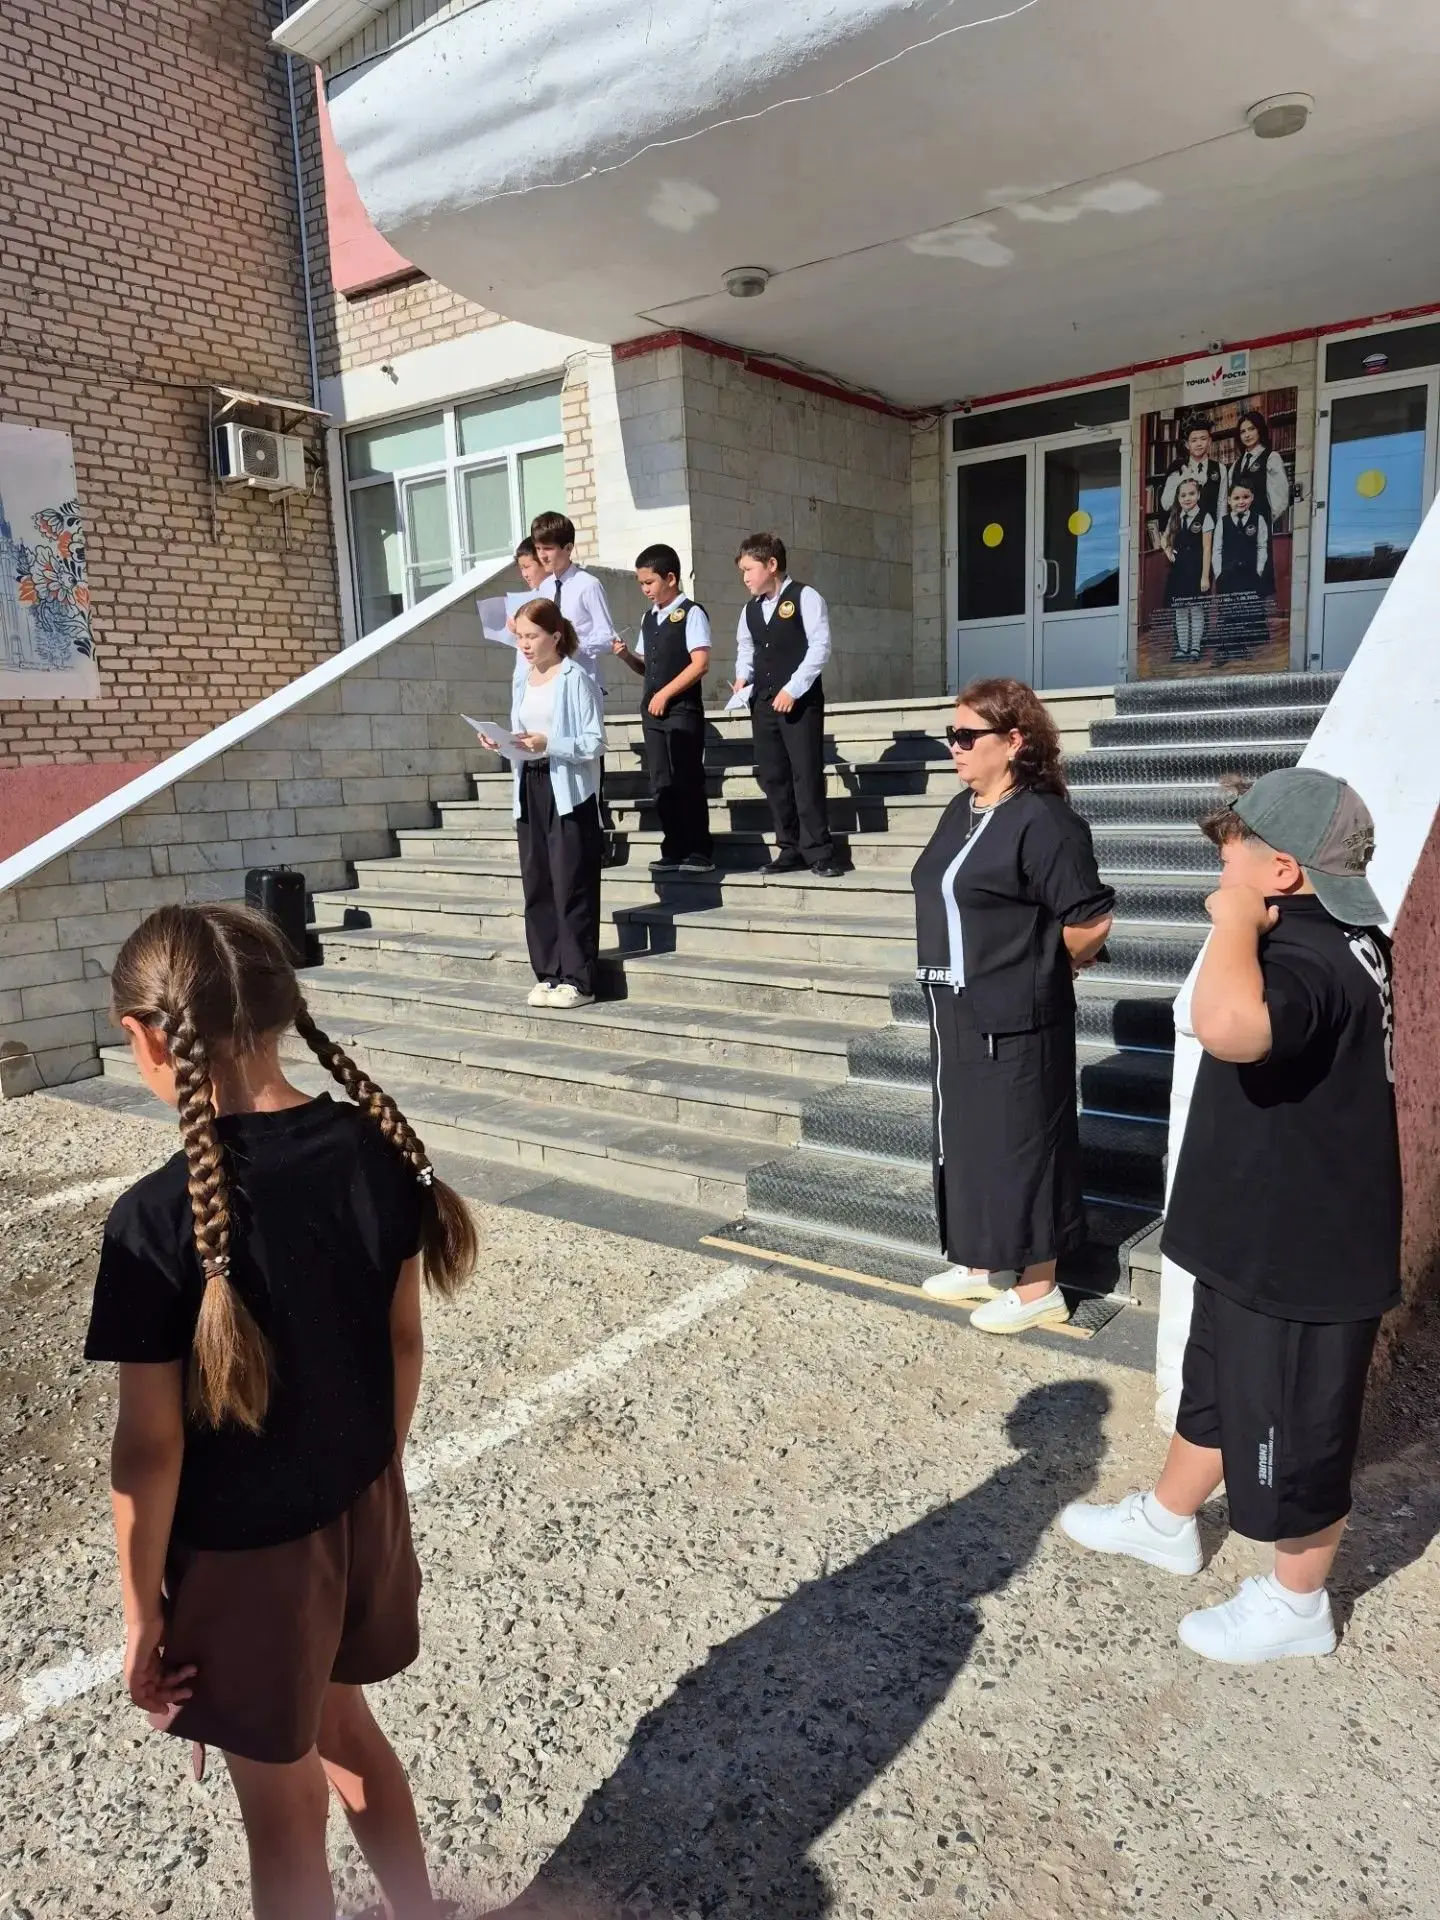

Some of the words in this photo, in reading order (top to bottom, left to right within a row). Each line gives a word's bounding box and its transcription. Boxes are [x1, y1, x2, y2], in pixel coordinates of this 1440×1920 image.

[1186, 377, 1210, 387] ТОЧКА
[1222, 370, 1247, 380] РОСТА
[928, 969, 952, 981] DRE
